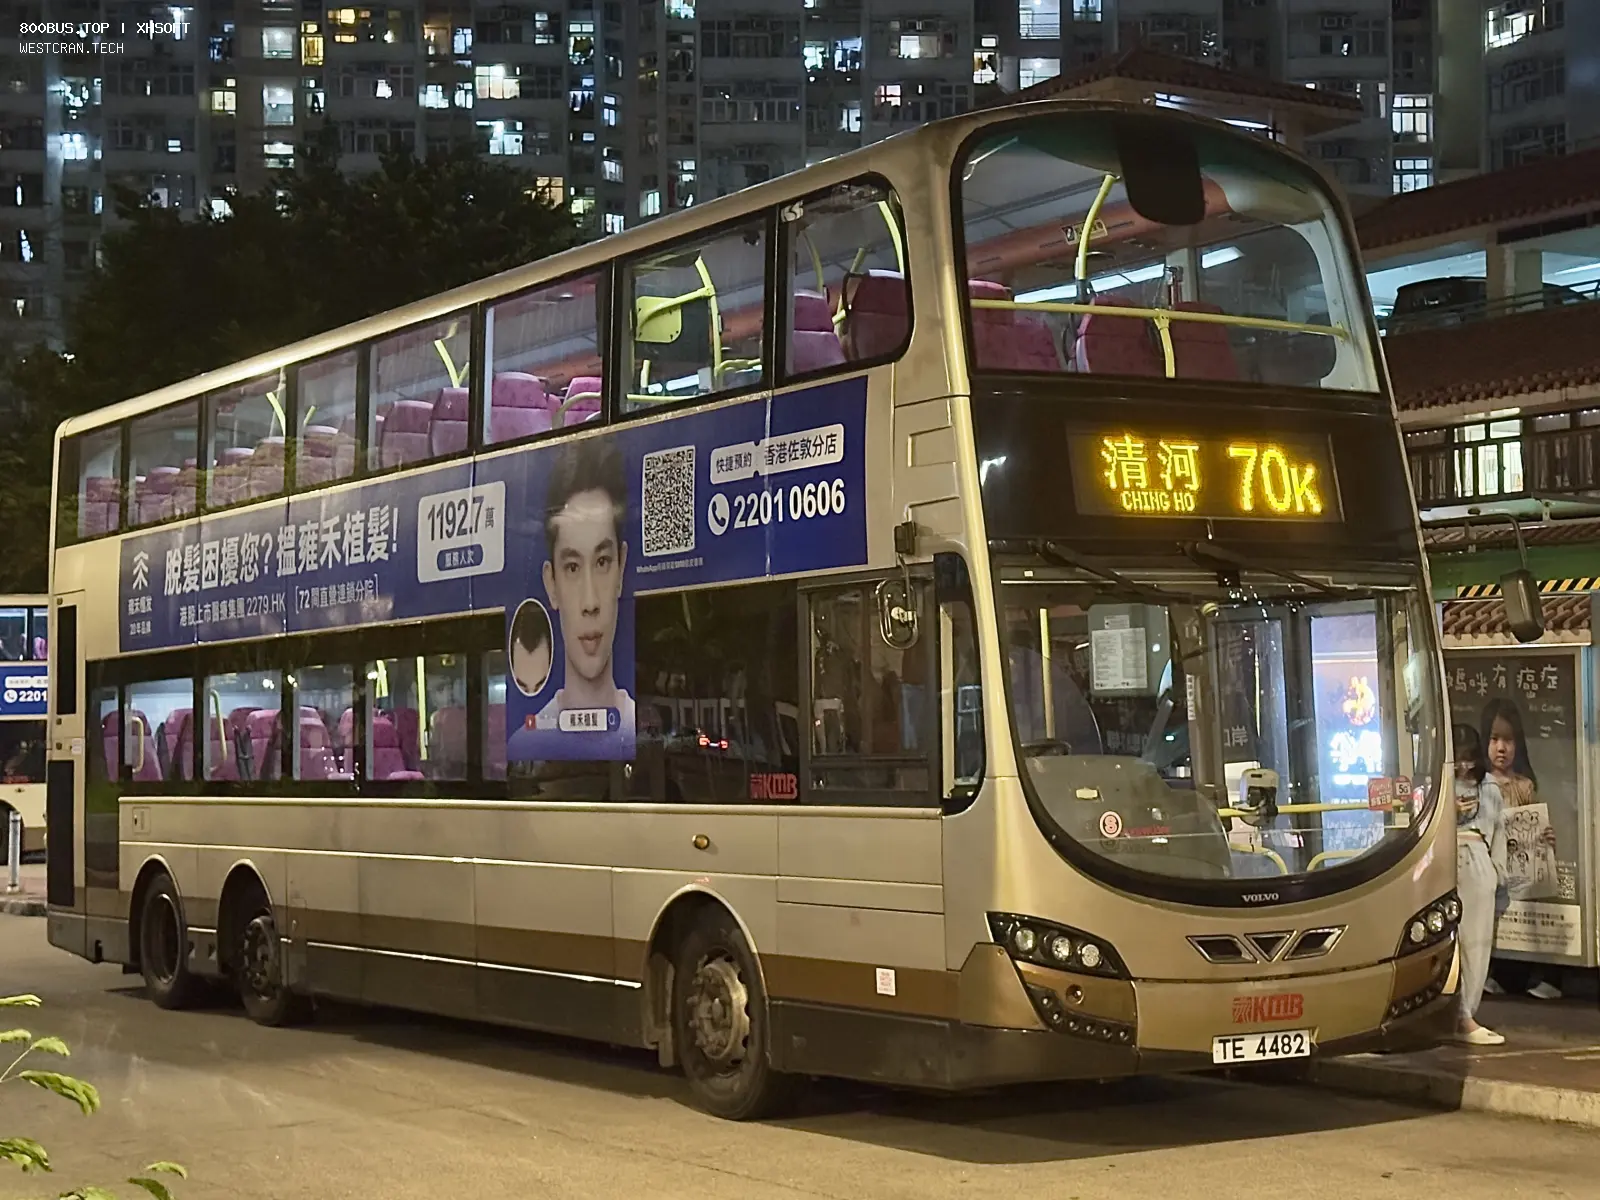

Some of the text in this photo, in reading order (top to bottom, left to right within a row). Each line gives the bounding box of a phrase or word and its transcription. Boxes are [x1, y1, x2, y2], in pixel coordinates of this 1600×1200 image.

[715, 451, 752, 474] 快捷預約
[764, 432, 837, 466] 香港佐敦分店
[1101, 434, 1199, 491] 清河
[1227, 444, 1323, 513] 70K
[733, 478, 846, 529] 2201 0606
[1121, 490, 1196, 512] CHING HO
[246, 592, 286, 617] 2279.HK
[1241, 892, 1280, 903] VOLVO
[1218, 1033, 1305, 1060] TE 4482
